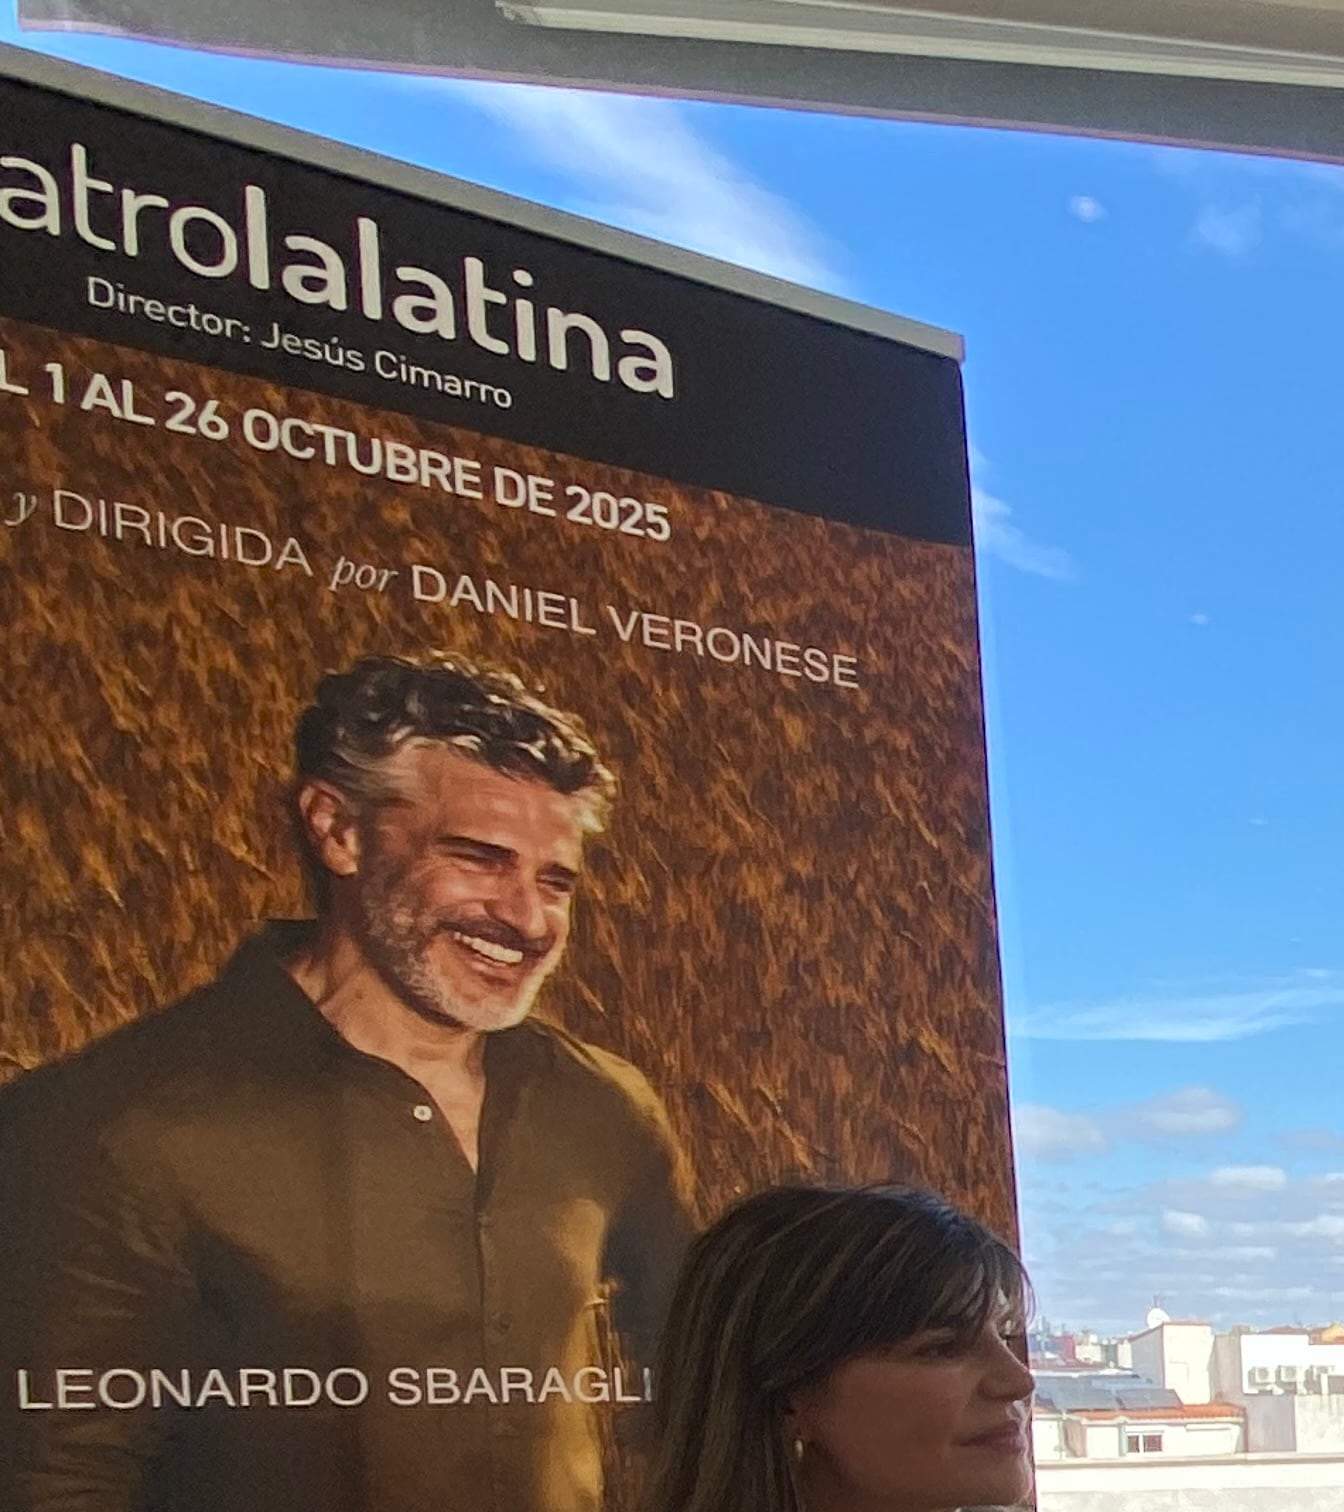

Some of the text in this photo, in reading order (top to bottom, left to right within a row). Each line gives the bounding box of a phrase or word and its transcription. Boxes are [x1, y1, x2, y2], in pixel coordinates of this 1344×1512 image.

[87, 276, 513, 409] Director: Jesús Cimarro
[44, 363, 65, 405] 1
[80, 373, 155, 426] AL
[165, 390, 230, 440] 26
[243, 408, 481, 500] OCTUBRE
[496, 469, 557, 519] DE
[566, 485, 672, 542] 2025
[5, 489, 860, 689] y DIRIGIDA por DANIEL VERONESE
[16, 1368, 369, 1411] LEONARDO
